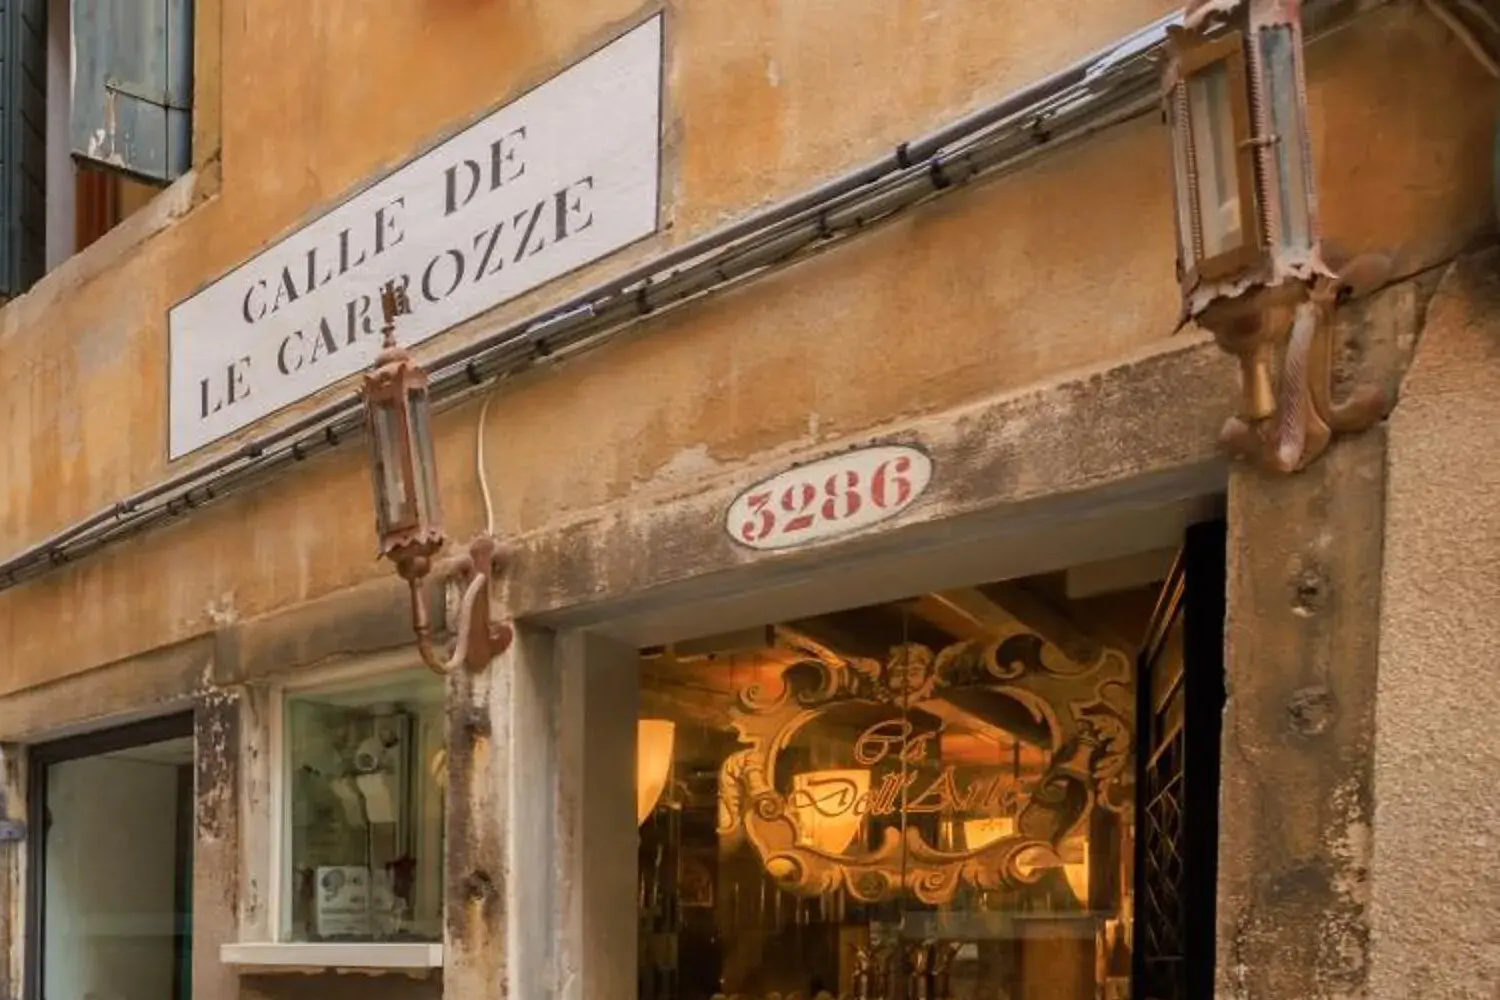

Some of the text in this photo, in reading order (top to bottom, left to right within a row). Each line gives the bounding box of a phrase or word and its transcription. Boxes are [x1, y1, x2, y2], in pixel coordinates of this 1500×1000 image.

[243, 126, 528, 324] CALLE DE
[199, 355, 252, 419] LE
[742, 456, 911, 541] 3286
